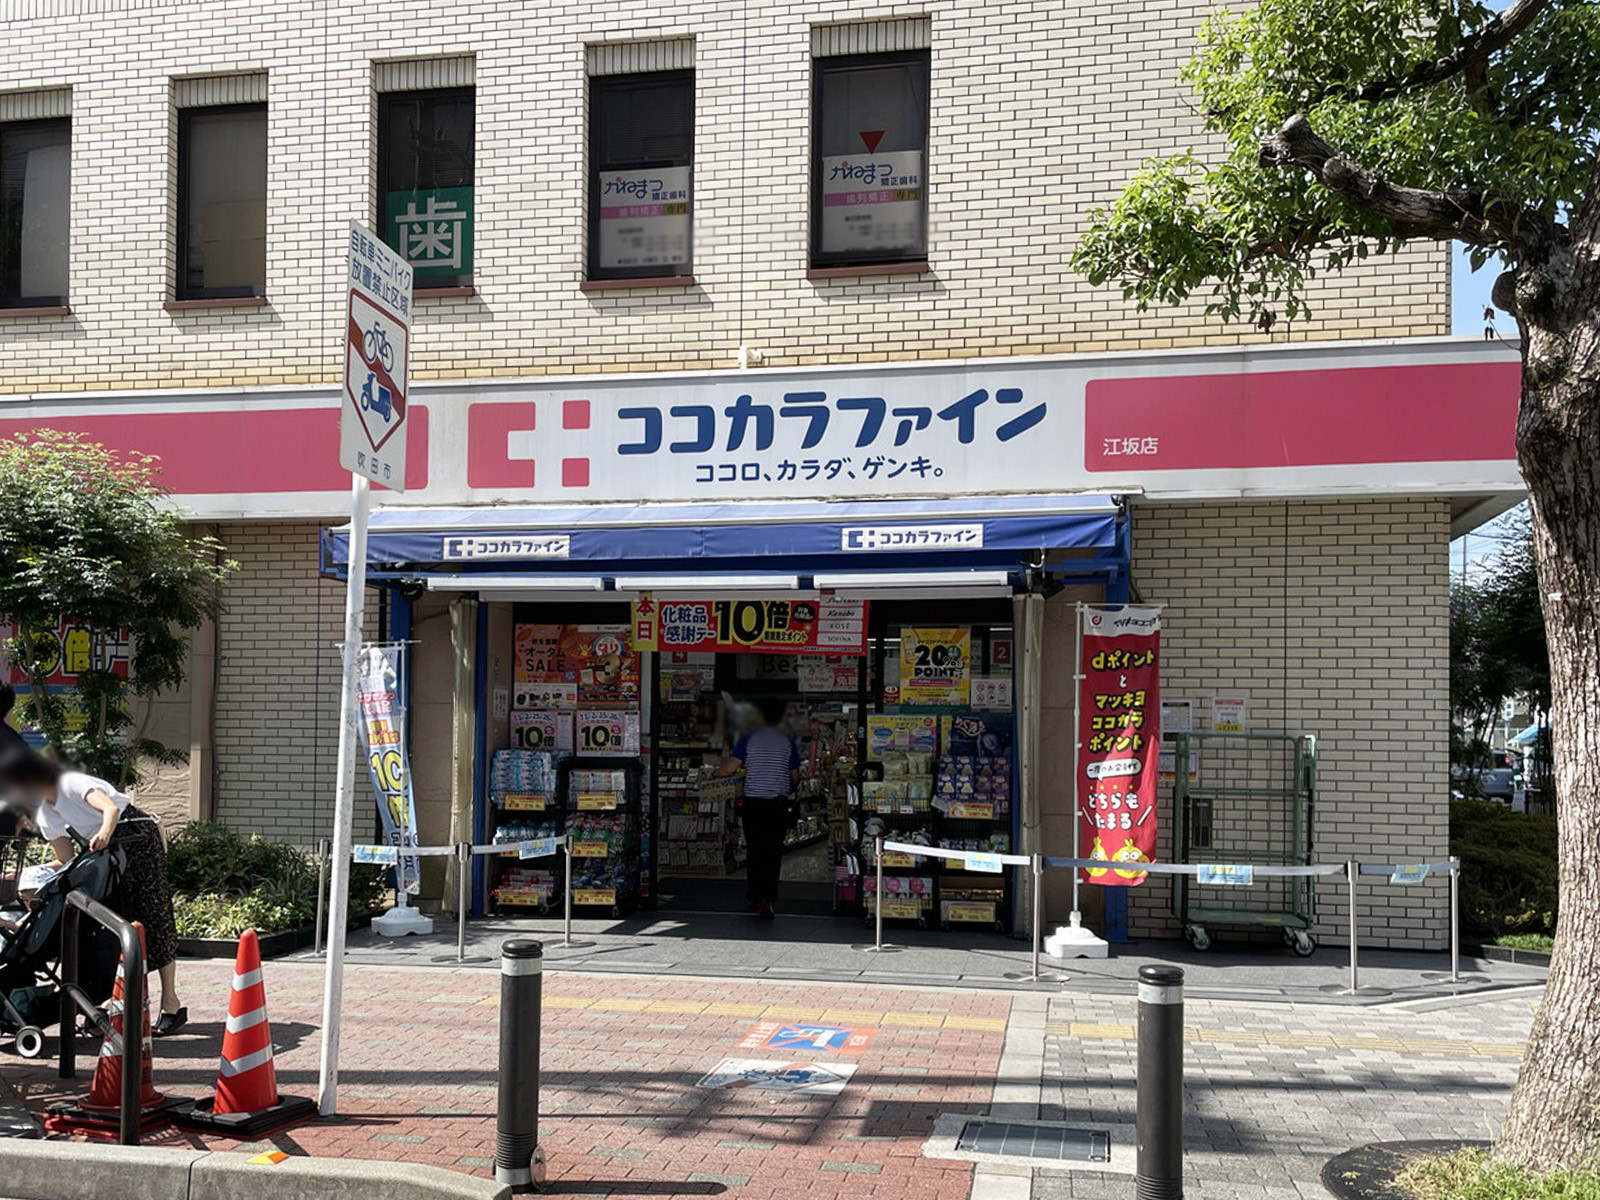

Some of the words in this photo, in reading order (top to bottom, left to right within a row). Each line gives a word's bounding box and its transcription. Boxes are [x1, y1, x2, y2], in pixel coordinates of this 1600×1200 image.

[395, 198, 467, 269] 歯
[351, 229, 411, 291] 自転車ミニバイク
[351, 257, 409, 317] 放置禁止区域
[617, 388, 1047, 455] ココカラファイン
[1102, 437, 1158, 456] 江坂店
[357, 451, 392, 480] 吹田市
[696, 455, 944, 482] ココロ、カラダ、ゲンキ。
[877, 530, 977, 544] ココカラファイン
[477, 541, 565, 554] ココカラファイン
[636, 596, 656, 640] 本日
[662, 605, 708, 624] 化粧品
[665, 626, 717, 642] 感謝デー
[524, 647, 566, 658] オータム
[997, 647, 1007, 659] 2
[1091, 648, 1155, 671] dポイント
[525, 659, 565, 672] SALE
[914, 667, 956, 677] POINT
[1119, 674, 1127, 688] と
[1091, 711, 1144, 730] ココカラ
[582, 725, 622, 748] 10倍
[1088, 732, 1143, 752] ポイント
[1088, 792, 1139, 810] どちらも
[1094, 812, 1132, 830] たまる
